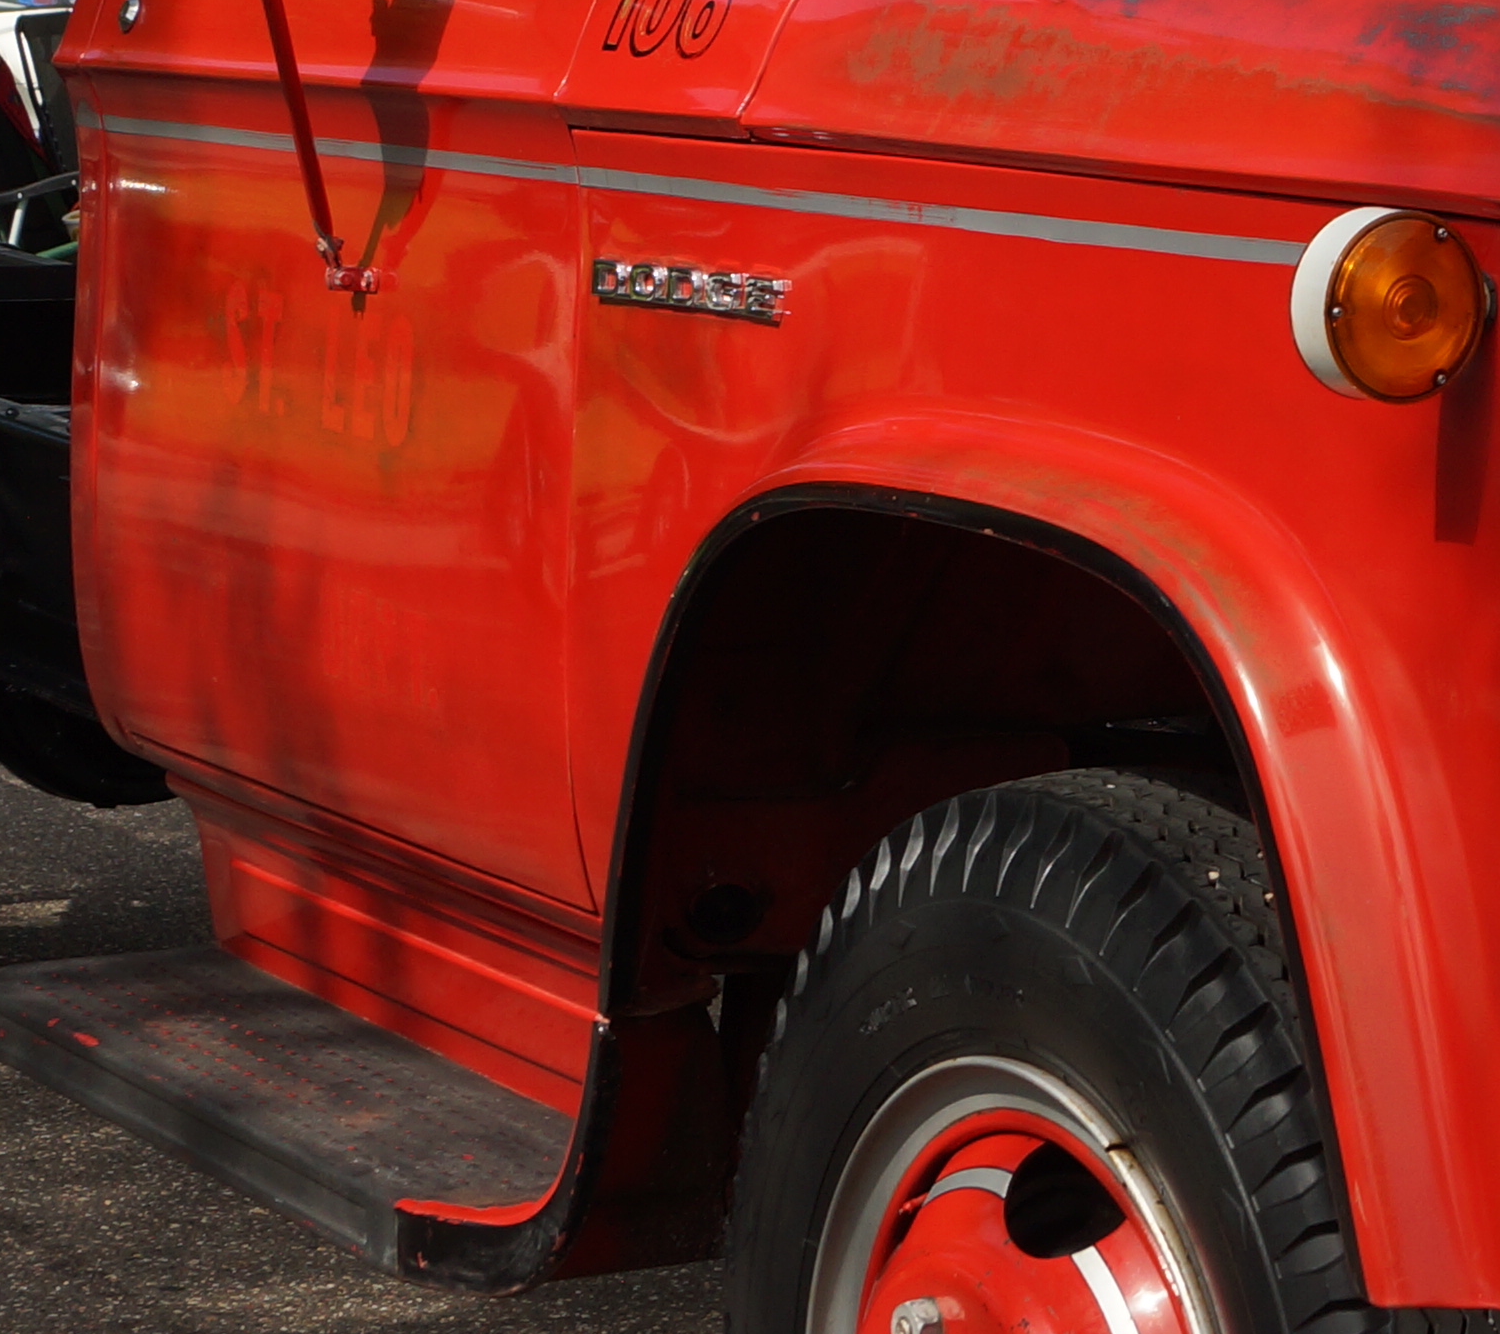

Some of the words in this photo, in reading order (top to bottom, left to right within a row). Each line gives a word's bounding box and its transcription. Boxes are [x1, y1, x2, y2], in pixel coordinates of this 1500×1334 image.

[592, 258, 792, 325] DODGE
[221, 280, 286, 417] ST.
[321, 305, 414, 447] LEO
